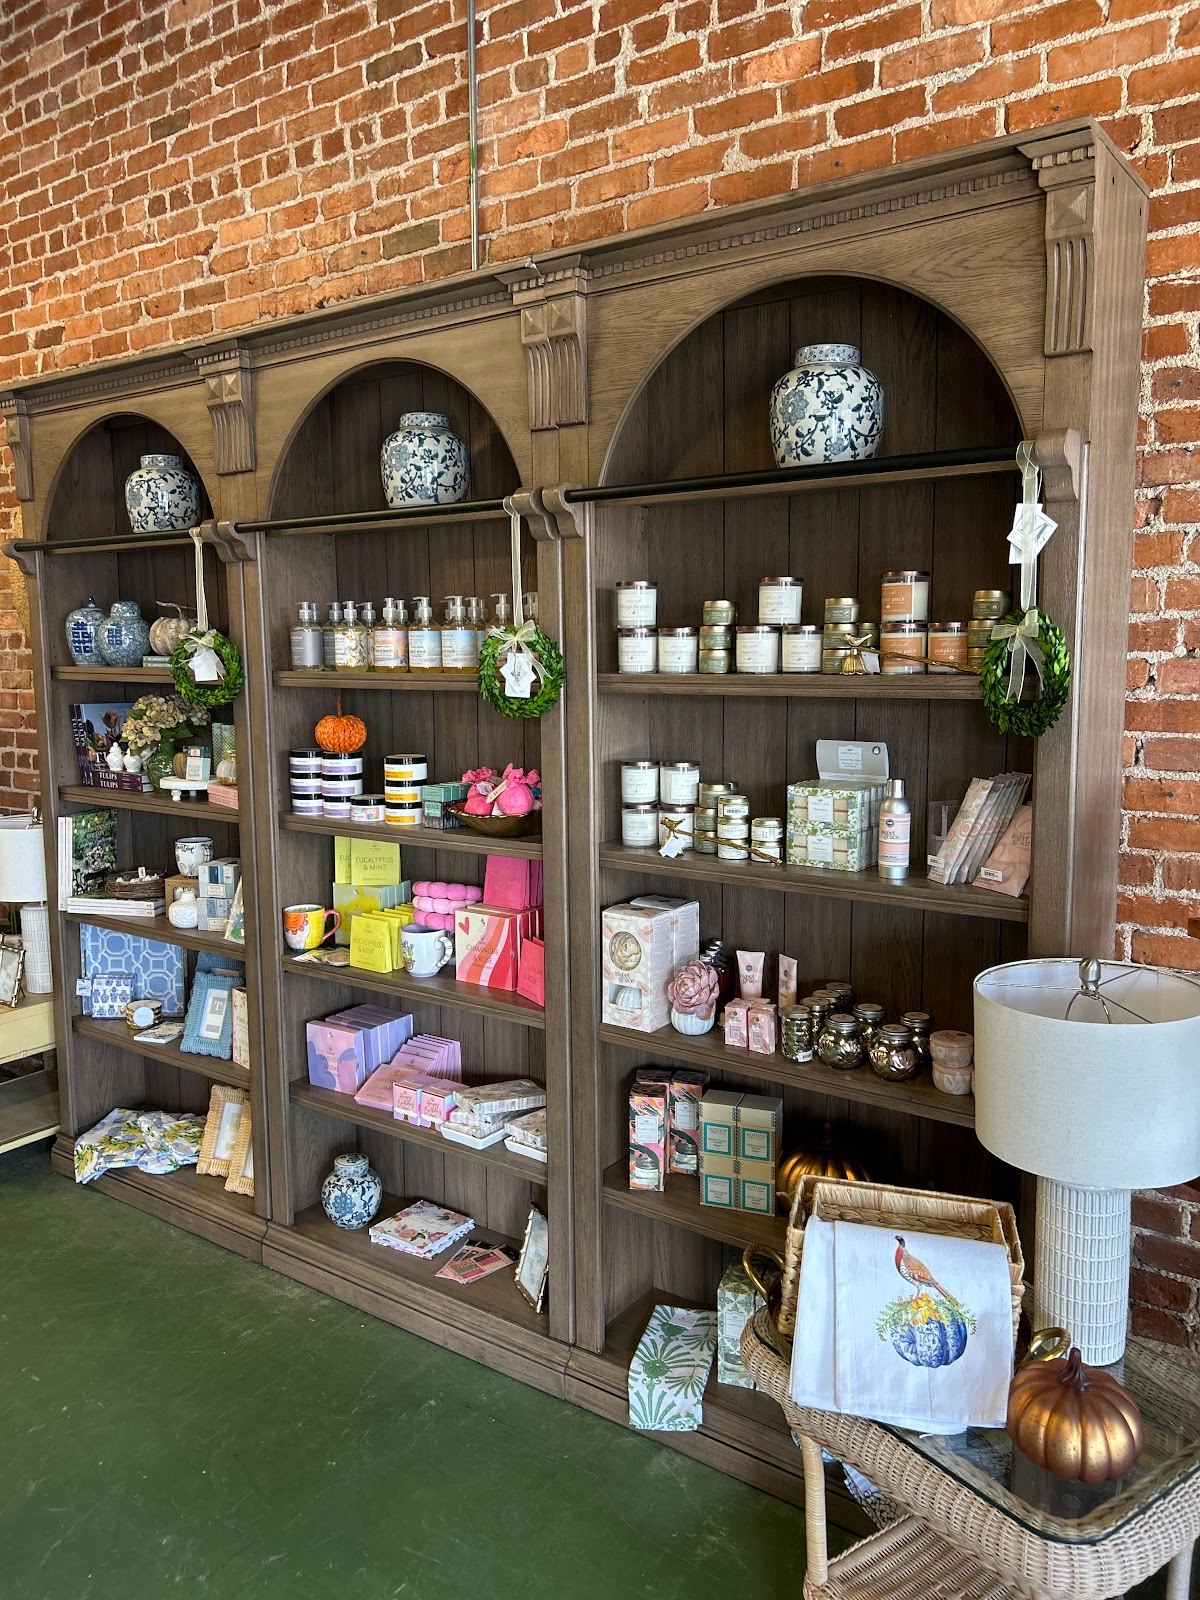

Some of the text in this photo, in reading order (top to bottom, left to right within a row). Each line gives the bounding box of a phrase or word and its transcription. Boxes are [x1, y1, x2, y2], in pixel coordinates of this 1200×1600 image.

[99, 771, 118, 780] TULIPS
[100, 780, 119, 789] TULIPS
[355, 856, 394, 864] EUCALYPTUS
